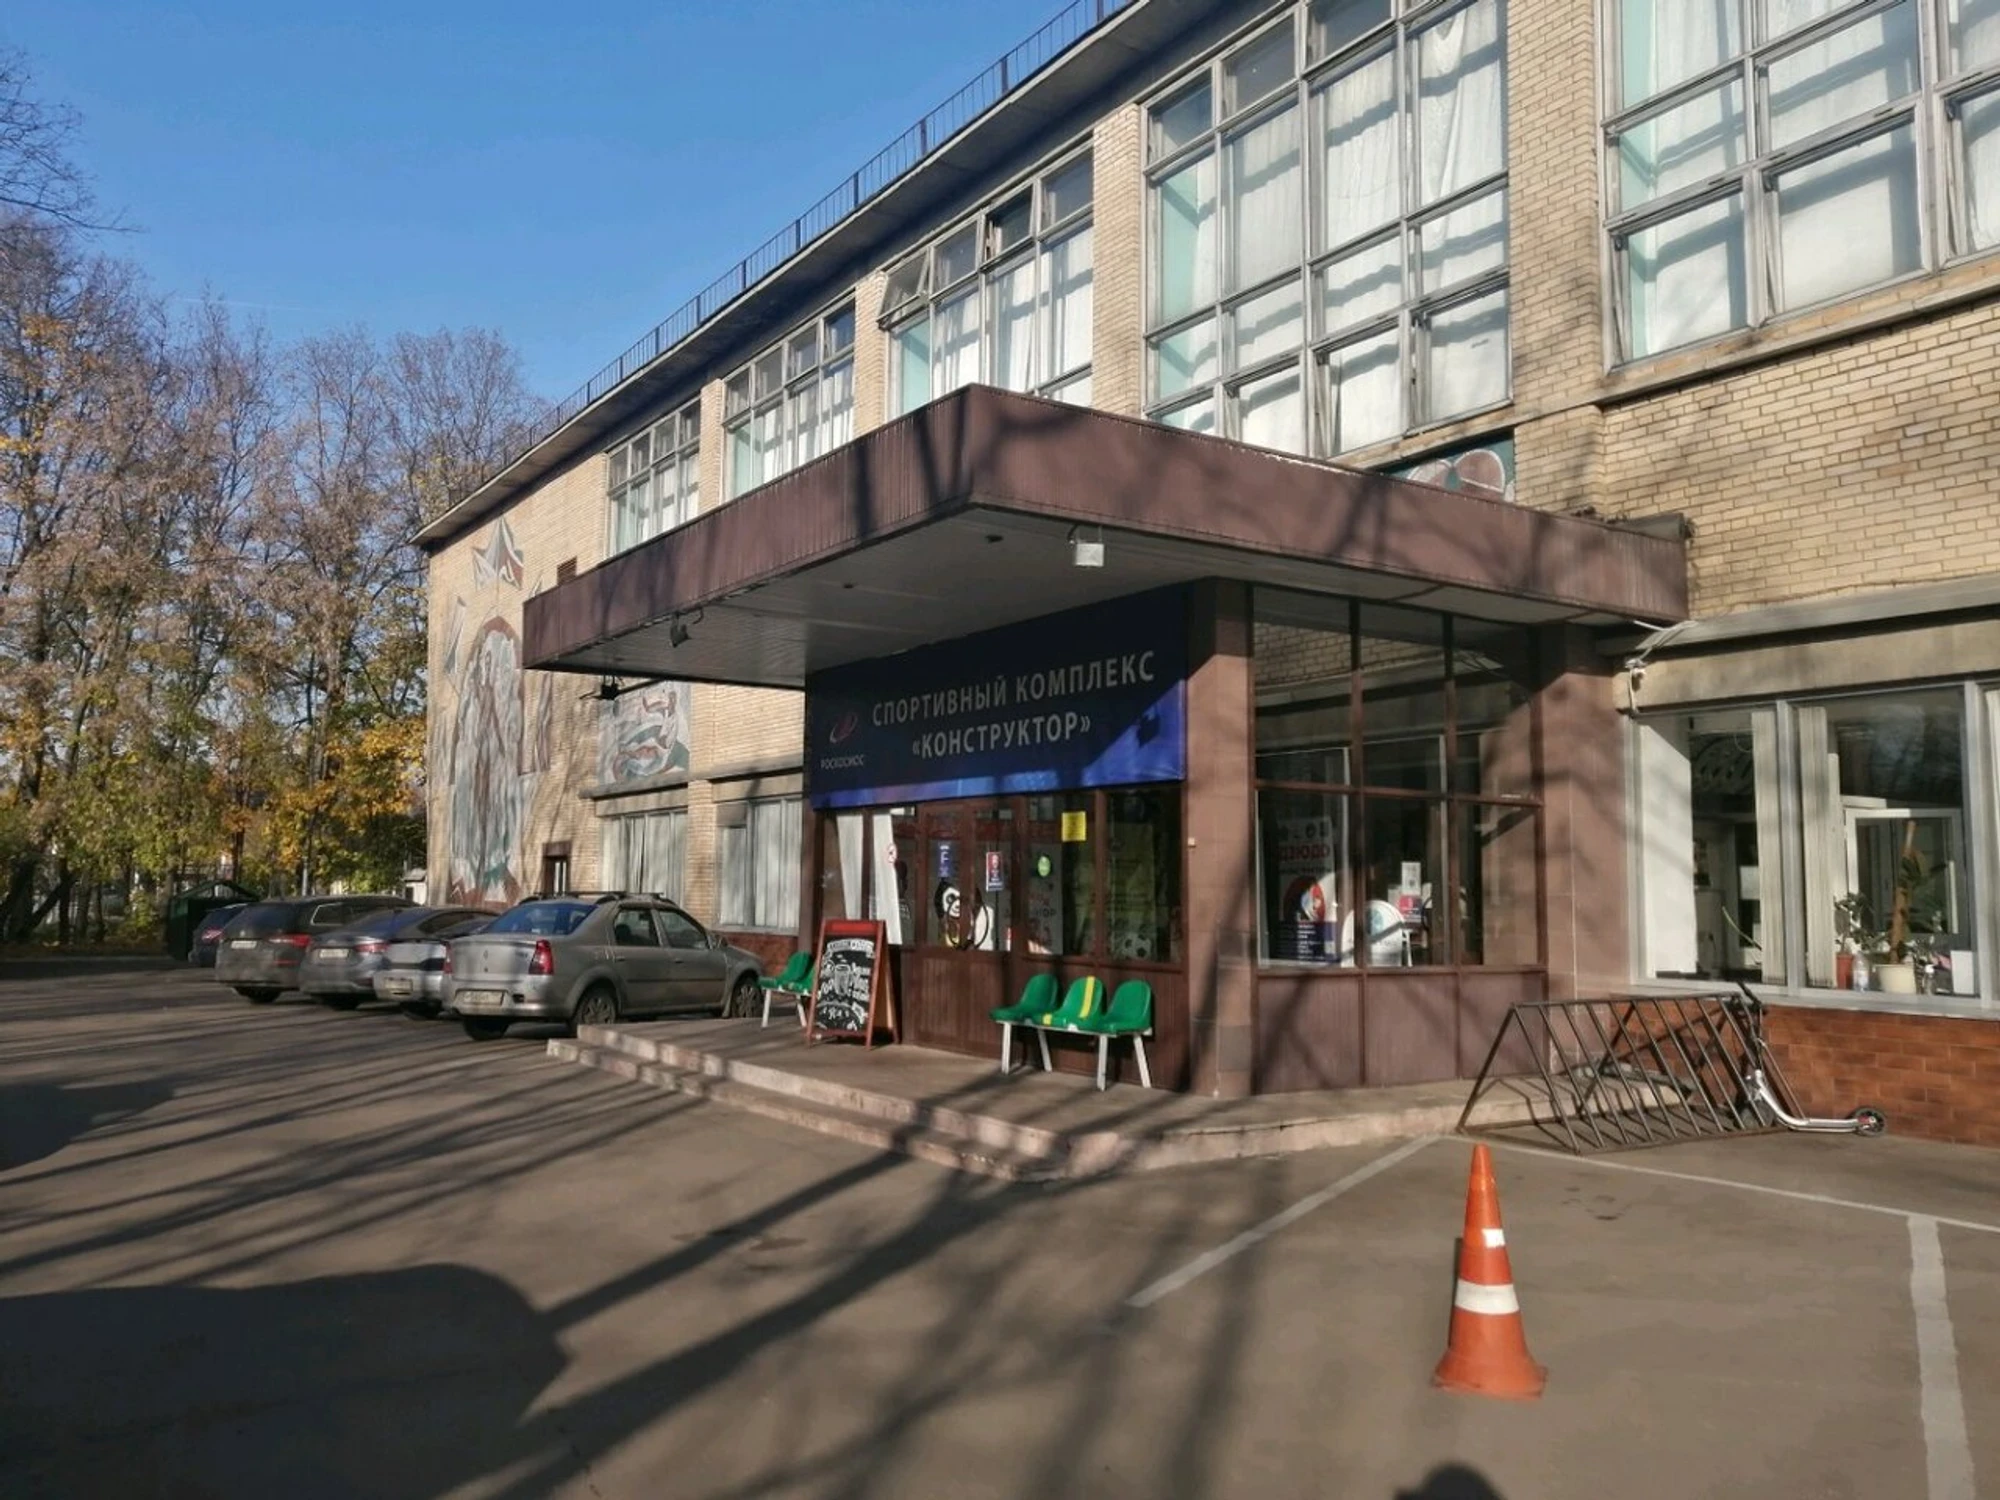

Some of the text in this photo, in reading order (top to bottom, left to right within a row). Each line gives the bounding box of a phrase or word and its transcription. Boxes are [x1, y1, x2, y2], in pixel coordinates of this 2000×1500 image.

[872, 650, 1155, 727] СПОРТИВНЫЙ КОМПЛЕКС
[912, 711, 1091, 759] «КОНСТРУКТОР»
